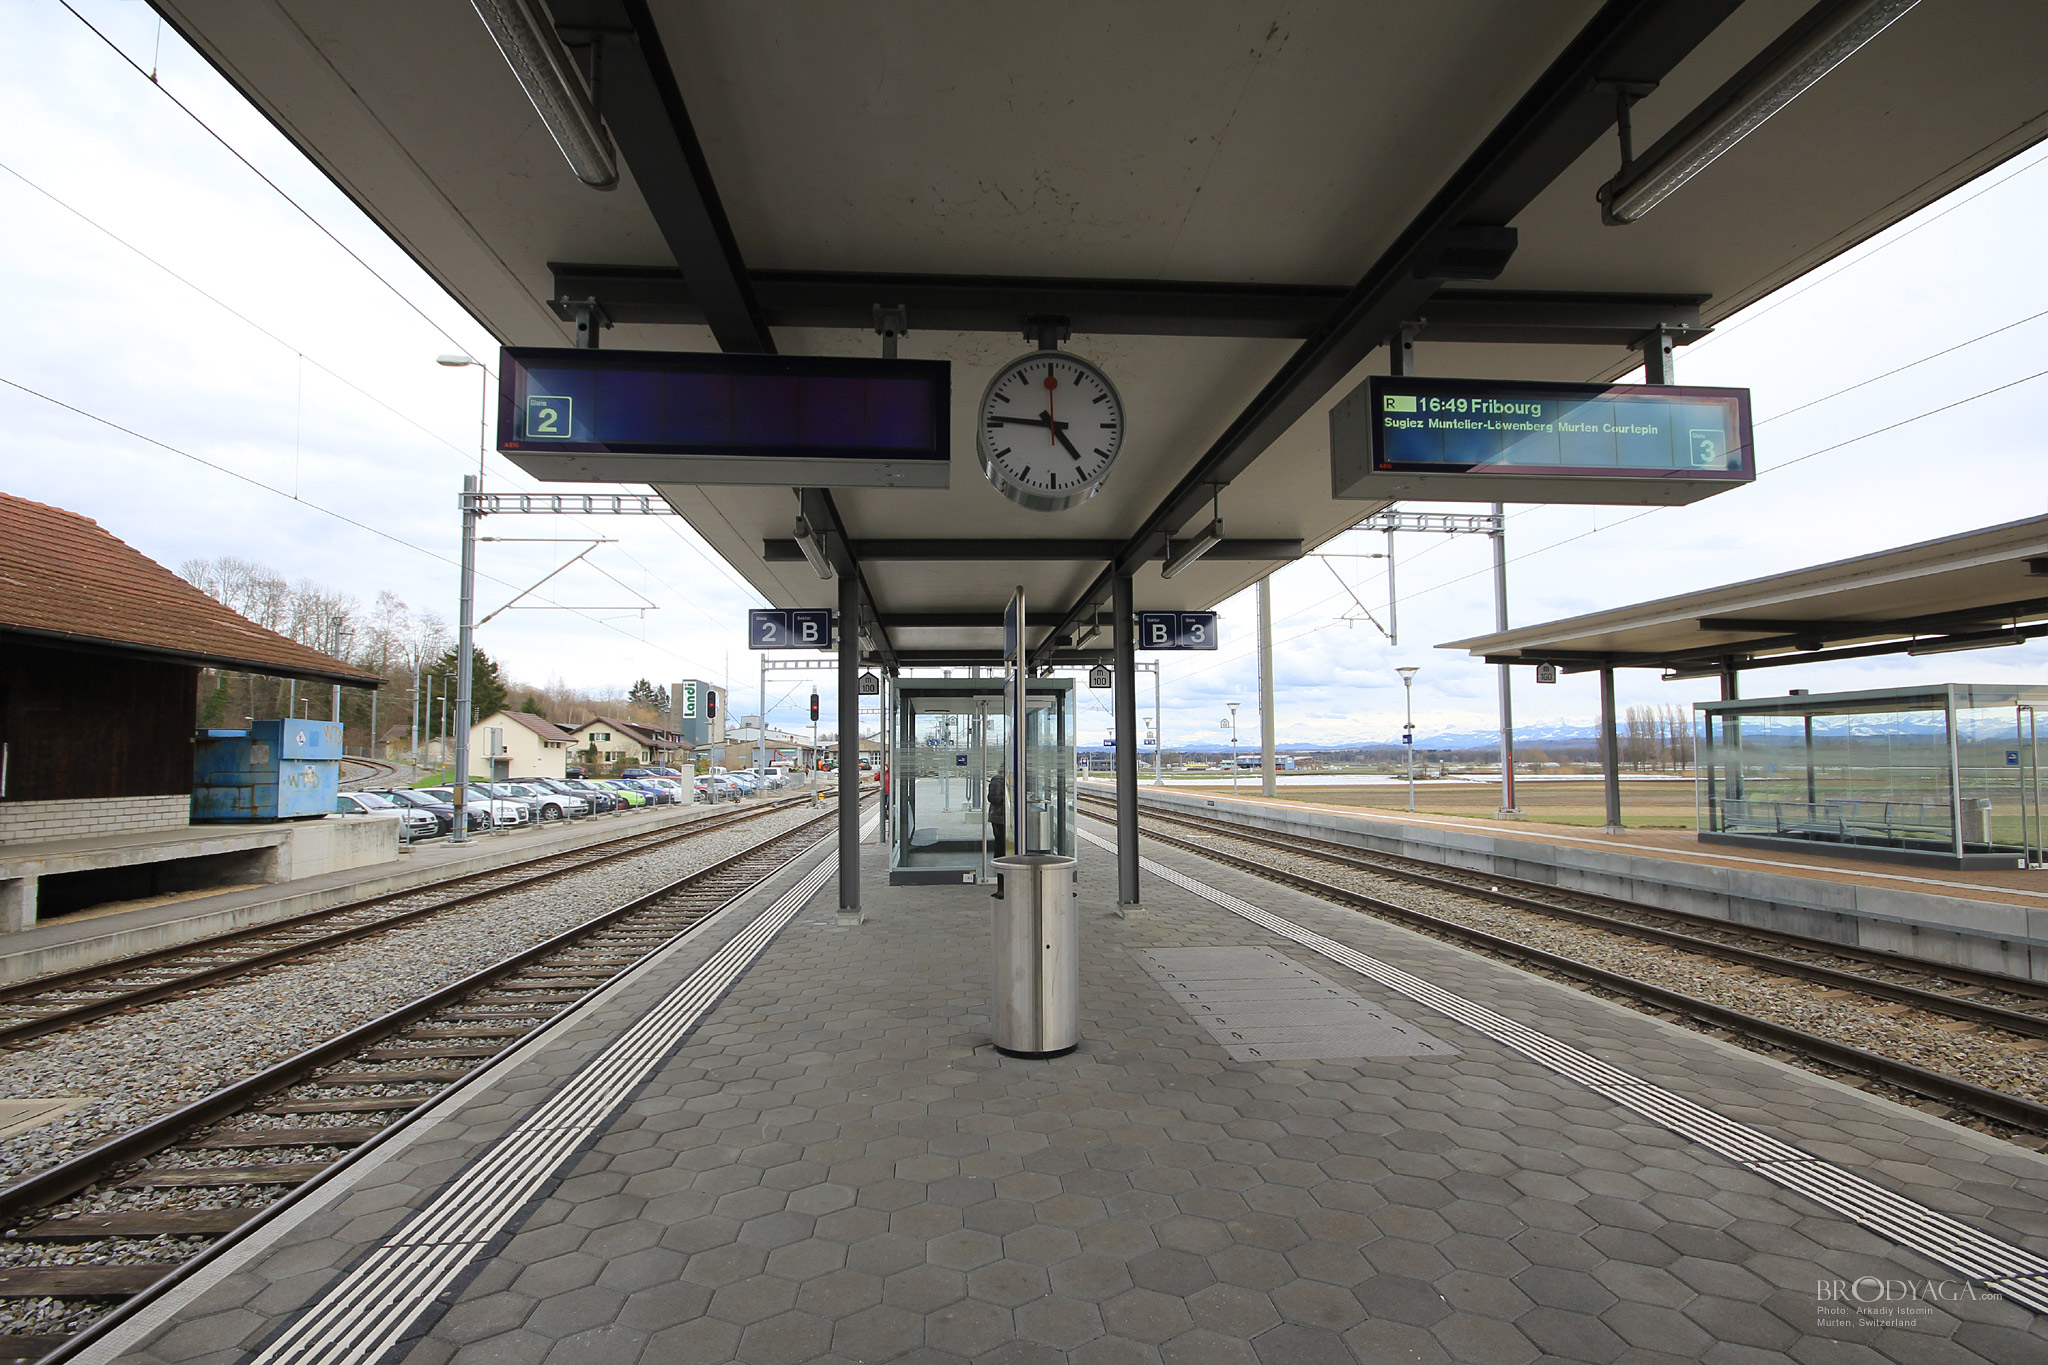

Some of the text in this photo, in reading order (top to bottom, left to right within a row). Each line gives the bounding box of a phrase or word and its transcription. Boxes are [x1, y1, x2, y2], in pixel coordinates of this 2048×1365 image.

[1386, 397, 1542, 417] R 16:49 Fribourg
[538, 408, 558, 432] 2
[1384, 417, 1658, 436] Sugiez Muntelier-Löwenberg Murten Courtepin
[1700, 440, 1715, 462] 3
[762, 622, 777, 642] 2
[802, 622, 819, 642] B
[1152, 624, 1168, 643] B
[1190, 624, 1206, 643] 3
[1093, 677, 1107, 686] 100
[1540, 673, 1552, 681] 100
[862, 684, 875, 693] 100
[684, 683, 695, 717] Landi
